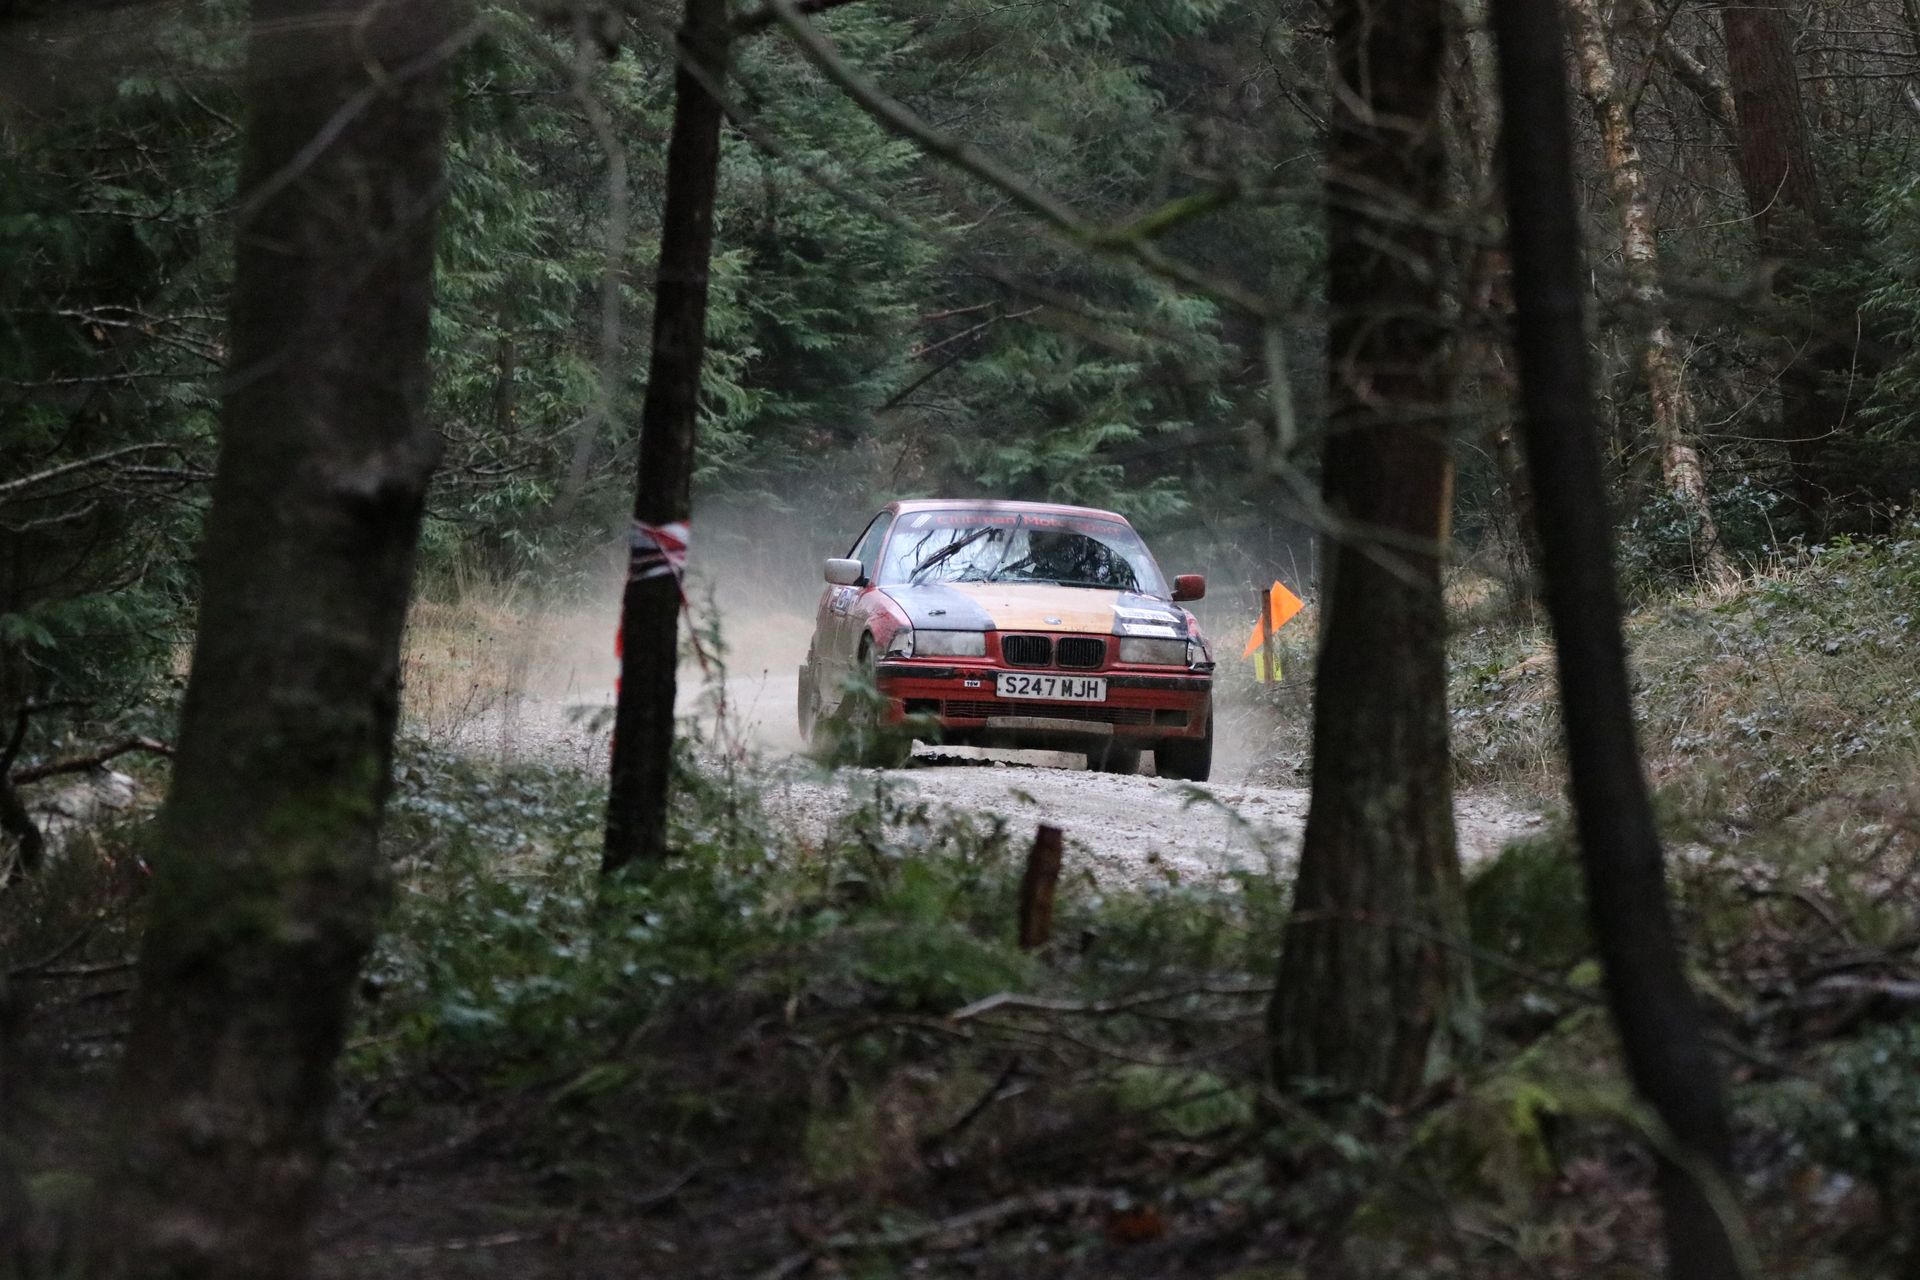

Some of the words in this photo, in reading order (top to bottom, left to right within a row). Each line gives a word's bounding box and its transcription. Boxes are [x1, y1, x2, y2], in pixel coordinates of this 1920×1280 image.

[1023, 515, 1120, 535] Motosport
[1005, 676, 1056, 696] S247
[1061, 679, 1098, 698] MJH
